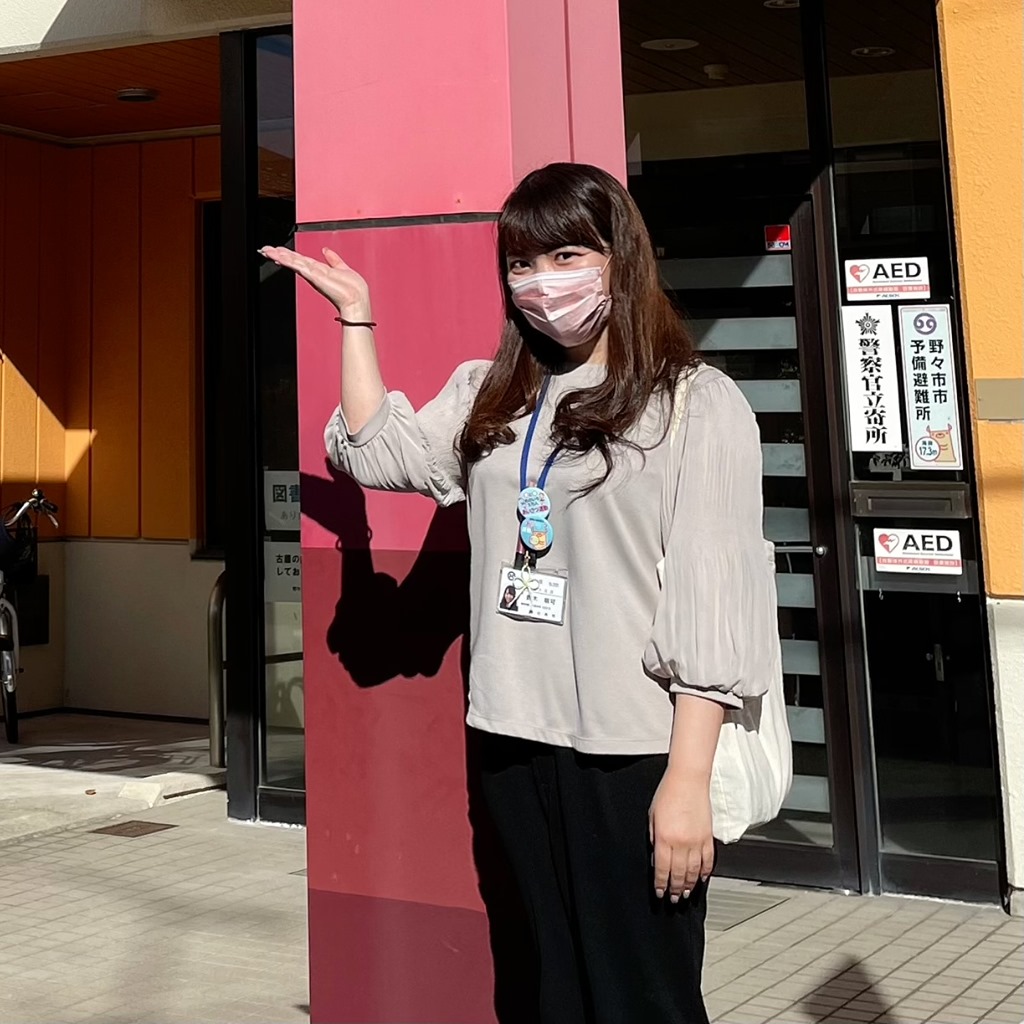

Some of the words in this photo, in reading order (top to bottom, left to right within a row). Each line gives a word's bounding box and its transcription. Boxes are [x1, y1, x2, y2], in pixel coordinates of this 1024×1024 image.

[872, 262, 922, 280] AED
[858, 337, 888, 445] 警察官立寄所
[910, 339, 931, 422] 予備避難所
[929, 339, 948, 405] 野々市市
[902, 534, 954, 552] AED
